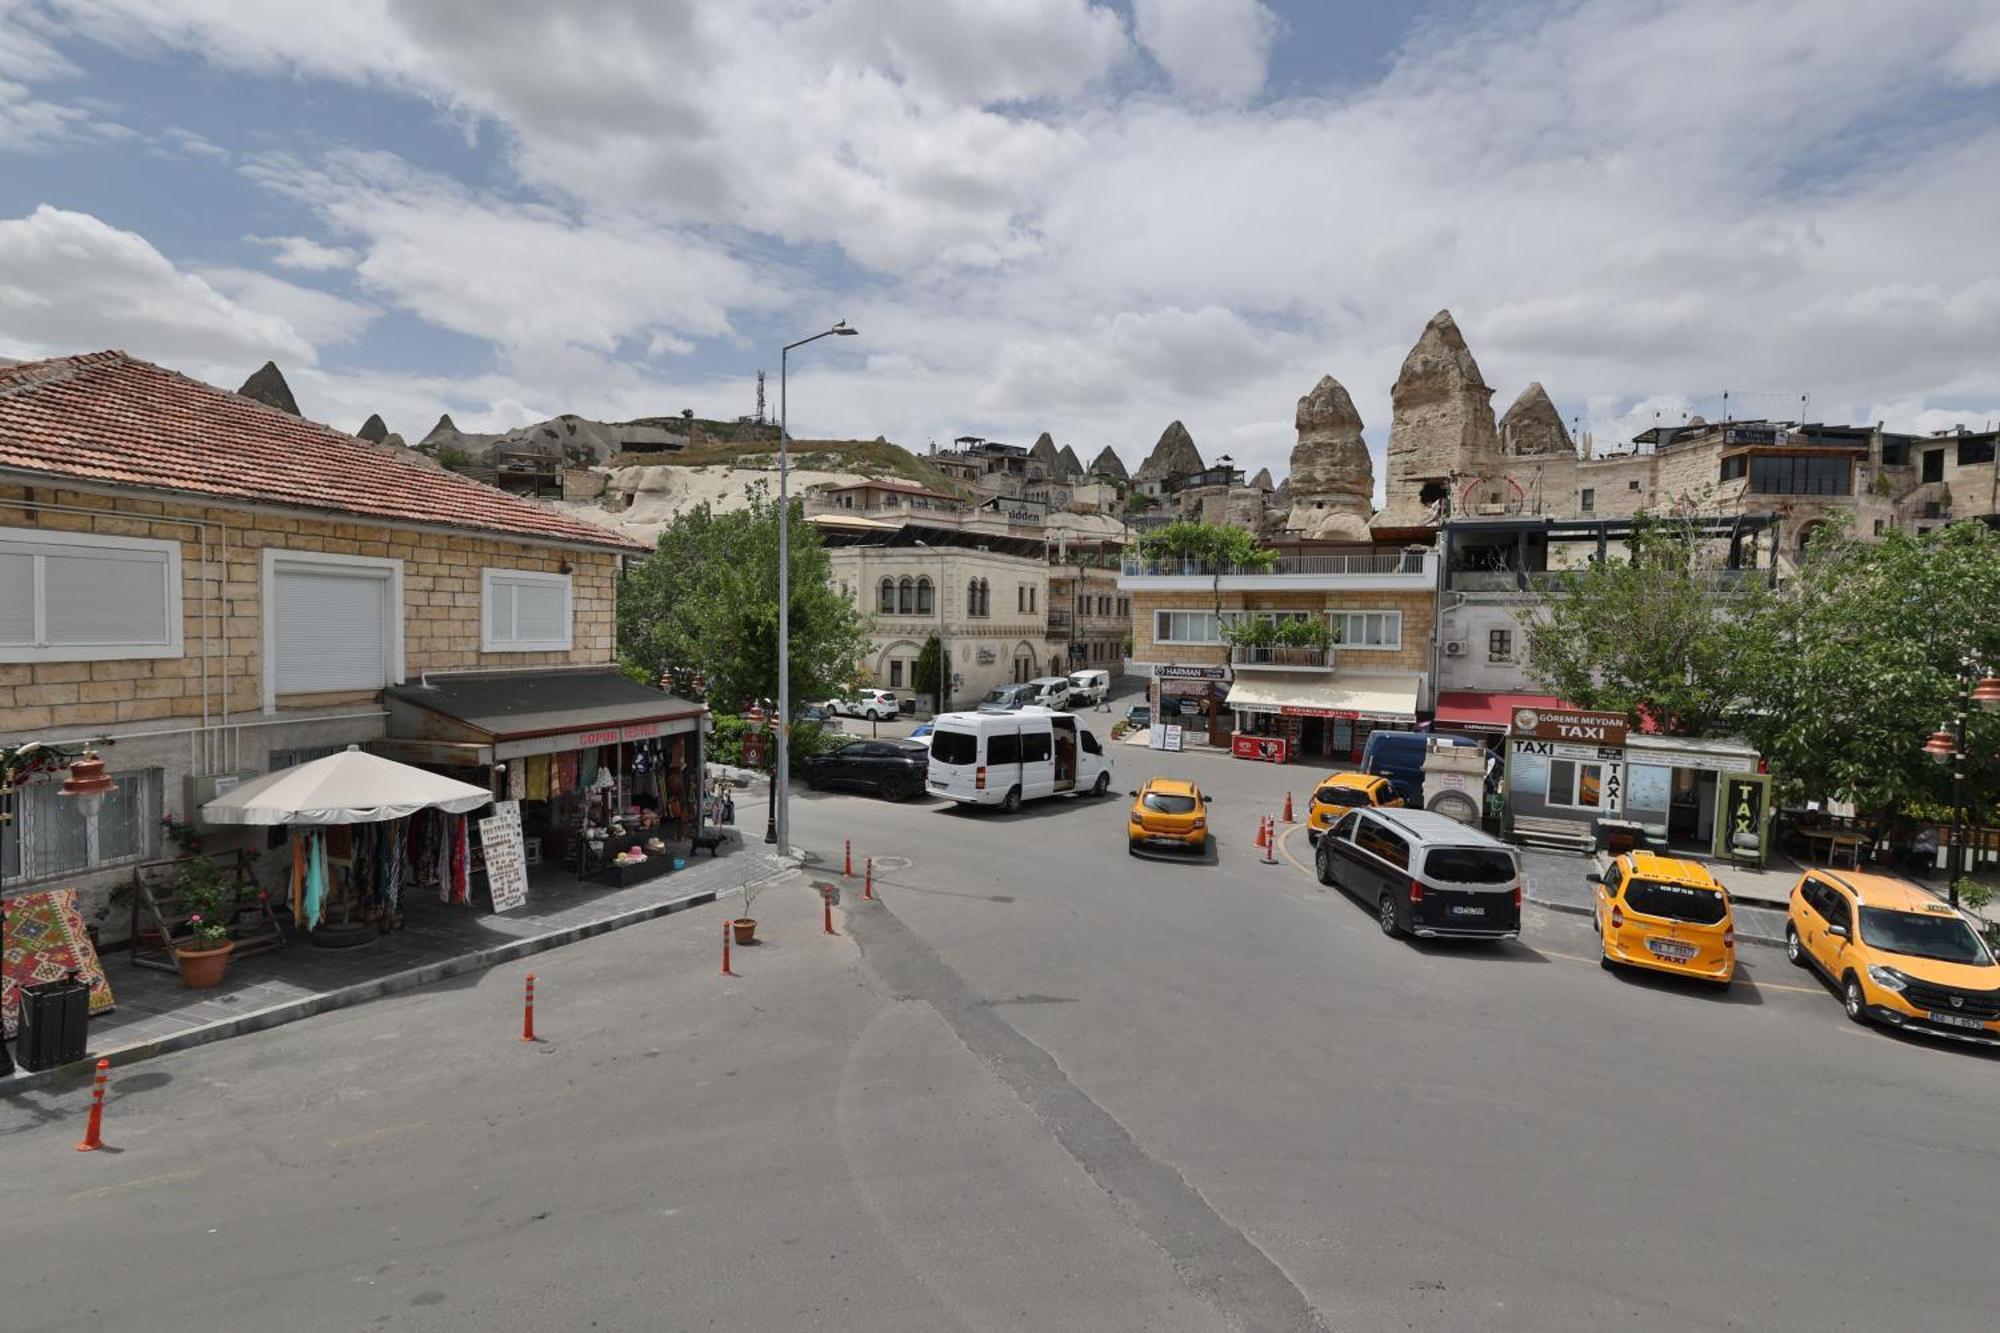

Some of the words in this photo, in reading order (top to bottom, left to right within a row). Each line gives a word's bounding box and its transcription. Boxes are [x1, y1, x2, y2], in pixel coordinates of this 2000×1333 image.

[1166, 667, 1201, 677] HARMAN
[1539, 713, 1579, 724] GÖREME
[1580, 717, 1624, 727] MEYDAN
[1557, 724, 1605, 739] TAXI
[1514, 740, 1554, 755] TAXI
[1607, 763, 1621, 810] TAXI
[1735, 785, 1753, 833] TAX
[1654, 953, 1688, 965] TAXI
